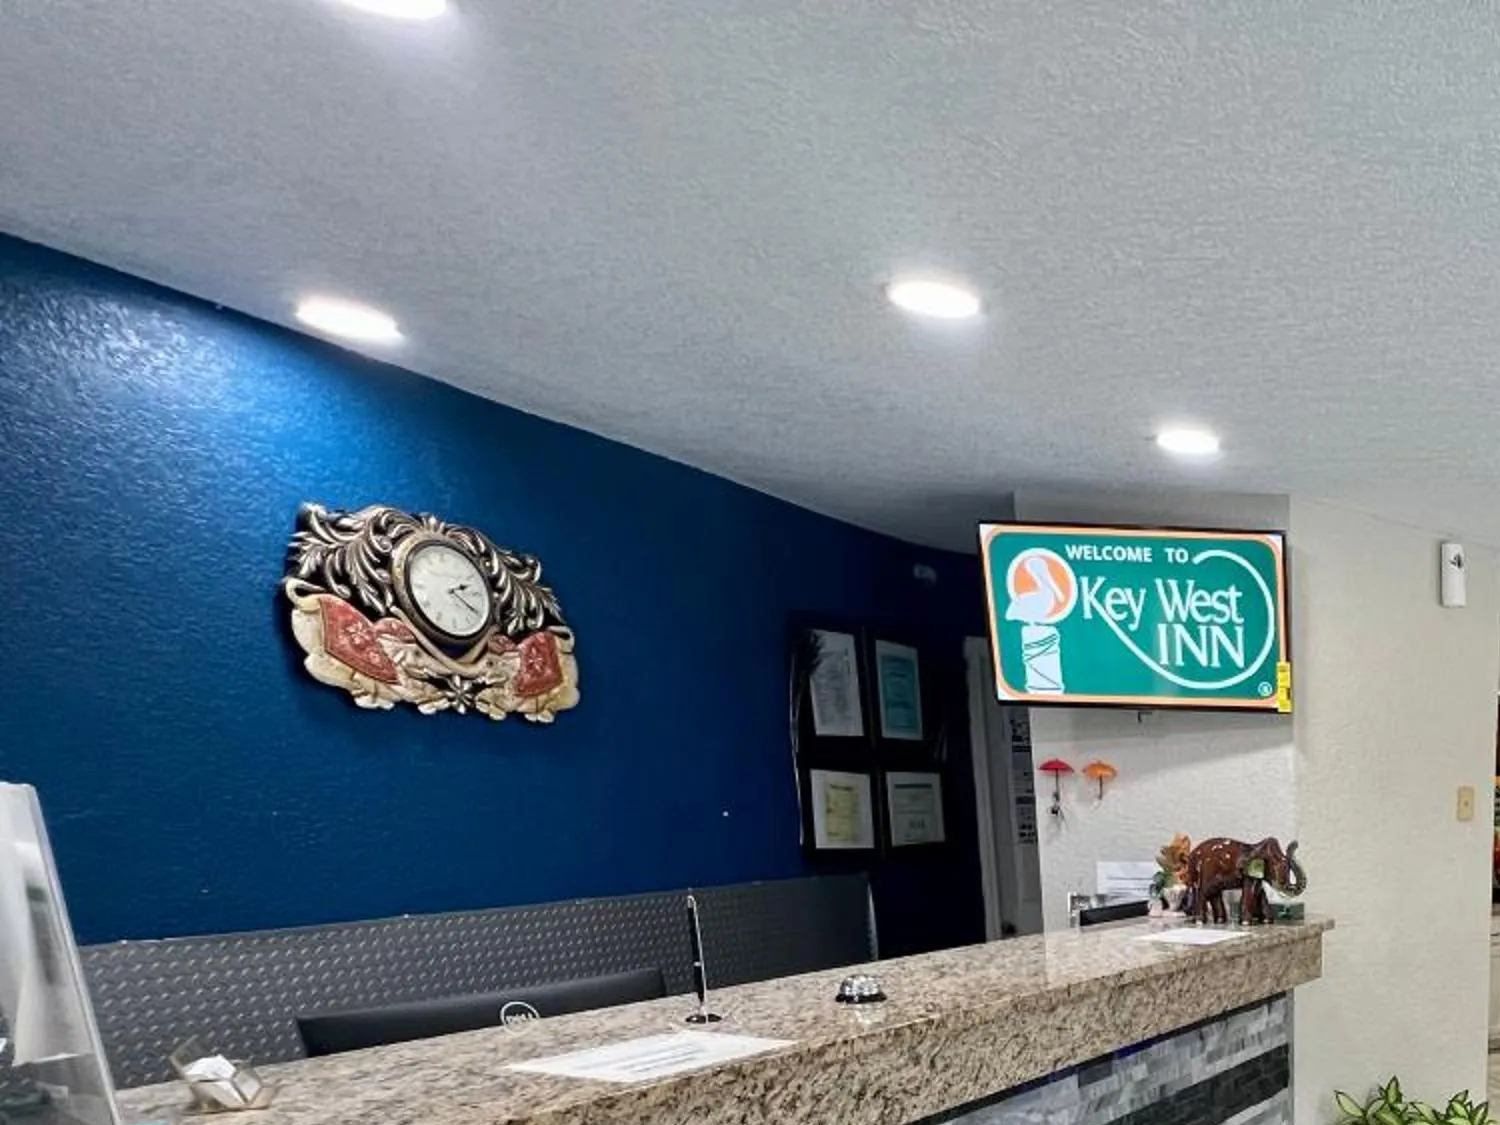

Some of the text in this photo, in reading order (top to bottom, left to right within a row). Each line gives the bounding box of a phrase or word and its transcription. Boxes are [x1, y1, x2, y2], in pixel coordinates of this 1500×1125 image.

[1065, 544, 1189, 564] WELCOME TO
[1080, 575, 1245, 631] Key West
[1157, 623, 1245, 669] INN
